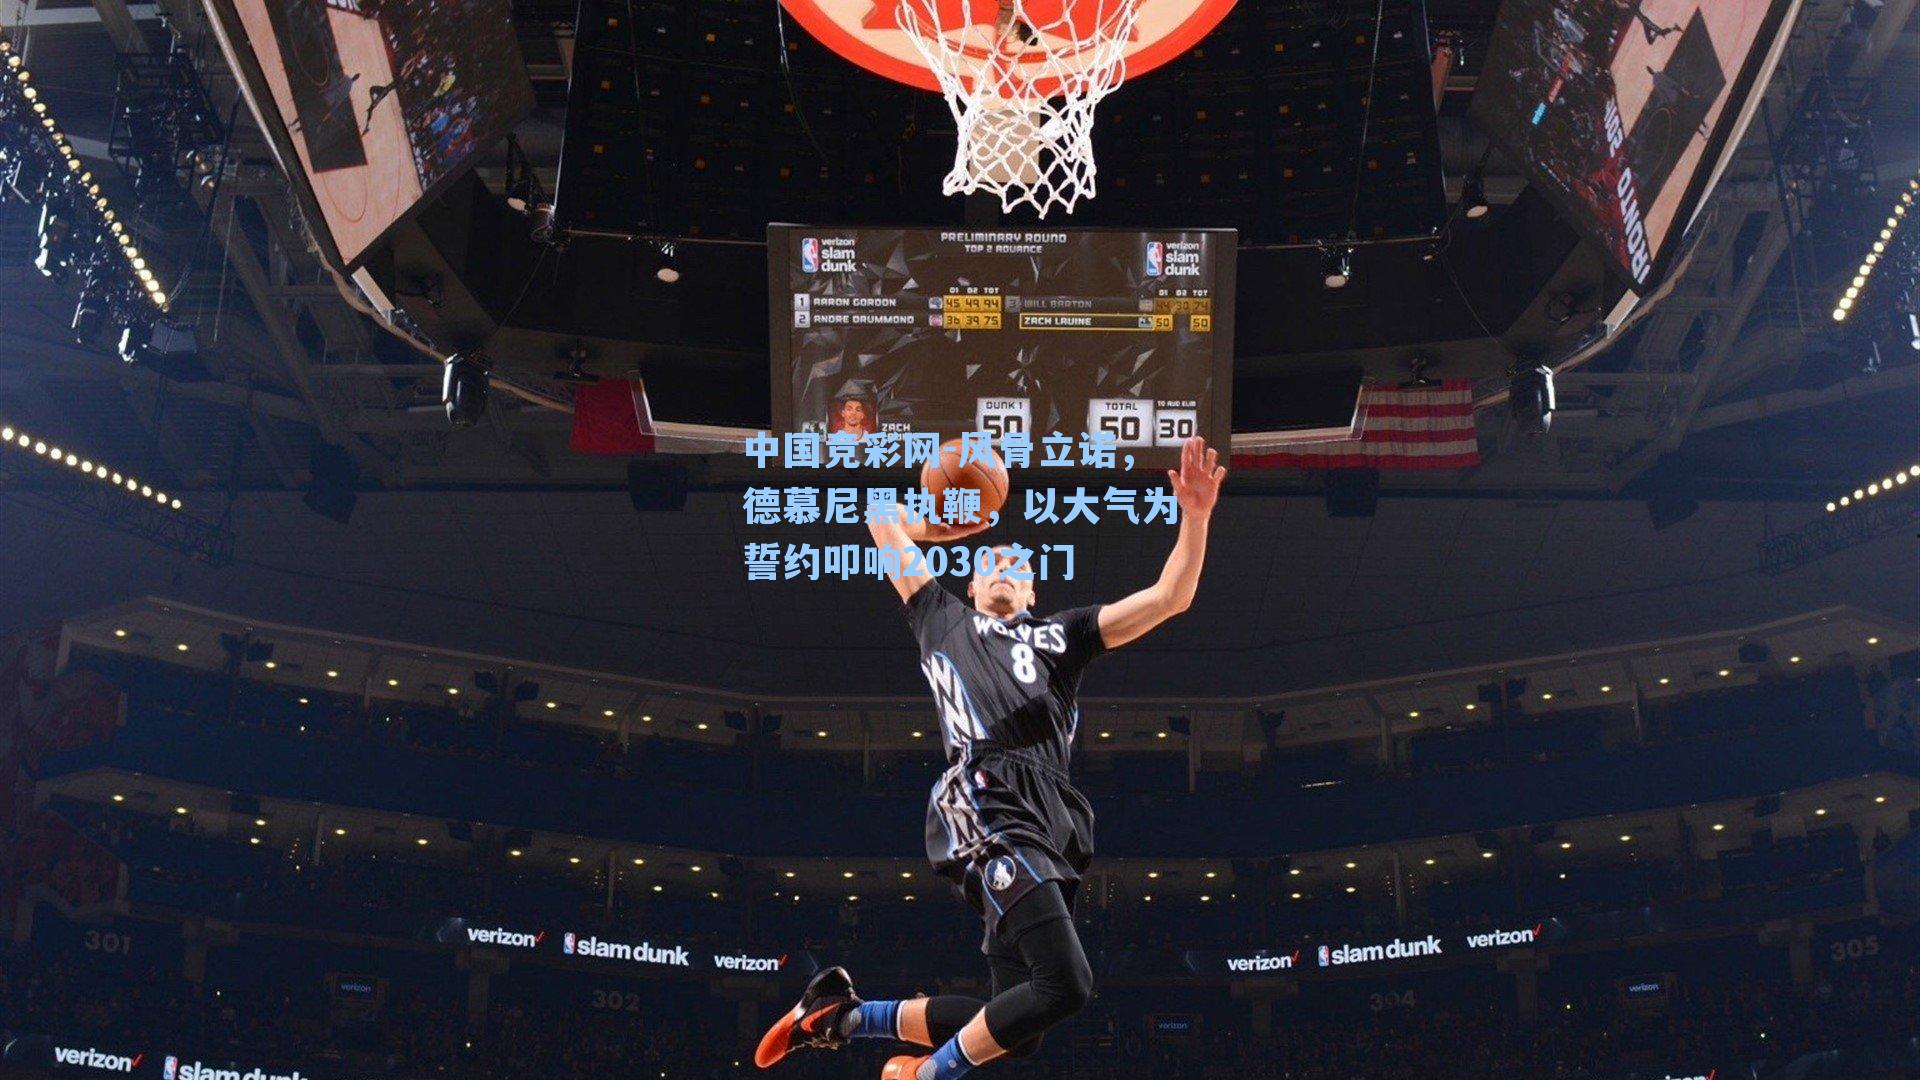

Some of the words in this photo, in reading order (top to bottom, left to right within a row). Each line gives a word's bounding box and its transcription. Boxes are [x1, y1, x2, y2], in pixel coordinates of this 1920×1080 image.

[821, 238, 855, 246] verizon
[940, 232, 1022, 244] PRELIMINARY
[1025, 233, 1067, 243] ROUND
[964, 244, 984, 254] TOP
[986, 245, 993, 253] 2
[1165, 242, 1199, 250] verizon
[821, 247, 855, 259] slam
[1165, 250, 1199, 263] slam
[821, 260, 857, 272] dunk
[1165, 263, 1200, 276] dunk
[813, 298, 850, 307] AARON
[853, 298, 896, 307] GORDON
[946, 299, 960, 308] 45
[965, 299, 980, 308] 49
[983, 299, 999, 308] 94
[813, 315, 849, 324] ANDRE
[852, 315, 915, 324] DRUMMOND
[965, 316, 980, 325] 39
[984, 316, 999, 325] 75
[1024, 317, 1052, 326] ZACH
[1156, 318, 1170, 328] 50
[1193, 318, 1208, 328] 50
[986, 401, 1015, 410] DUNK
[1105, 402, 1138, 411] TOTAL
[881, 423, 911, 432] ZACH
[983, 415, 1022, 439] 50
[1100, 416, 1140, 440] 50
[1160, 418, 1193, 438] 30
[973, 615, 1066, 654] WOLVES
[1011, 643, 1037, 683] 8
[467, 928, 536, 948] verizon
[1467, 927, 1534, 948] verizon
[577, 935, 631, 960] slam
[633, 941, 690, 966] dunk
[1331, 945, 1384, 965] slam
[1385, 935, 1443, 959] dunk
[714, 954, 778, 971] verizon
[1227, 954, 1292, 971] verizon
[55, 1046, 132, 1072] verizon
